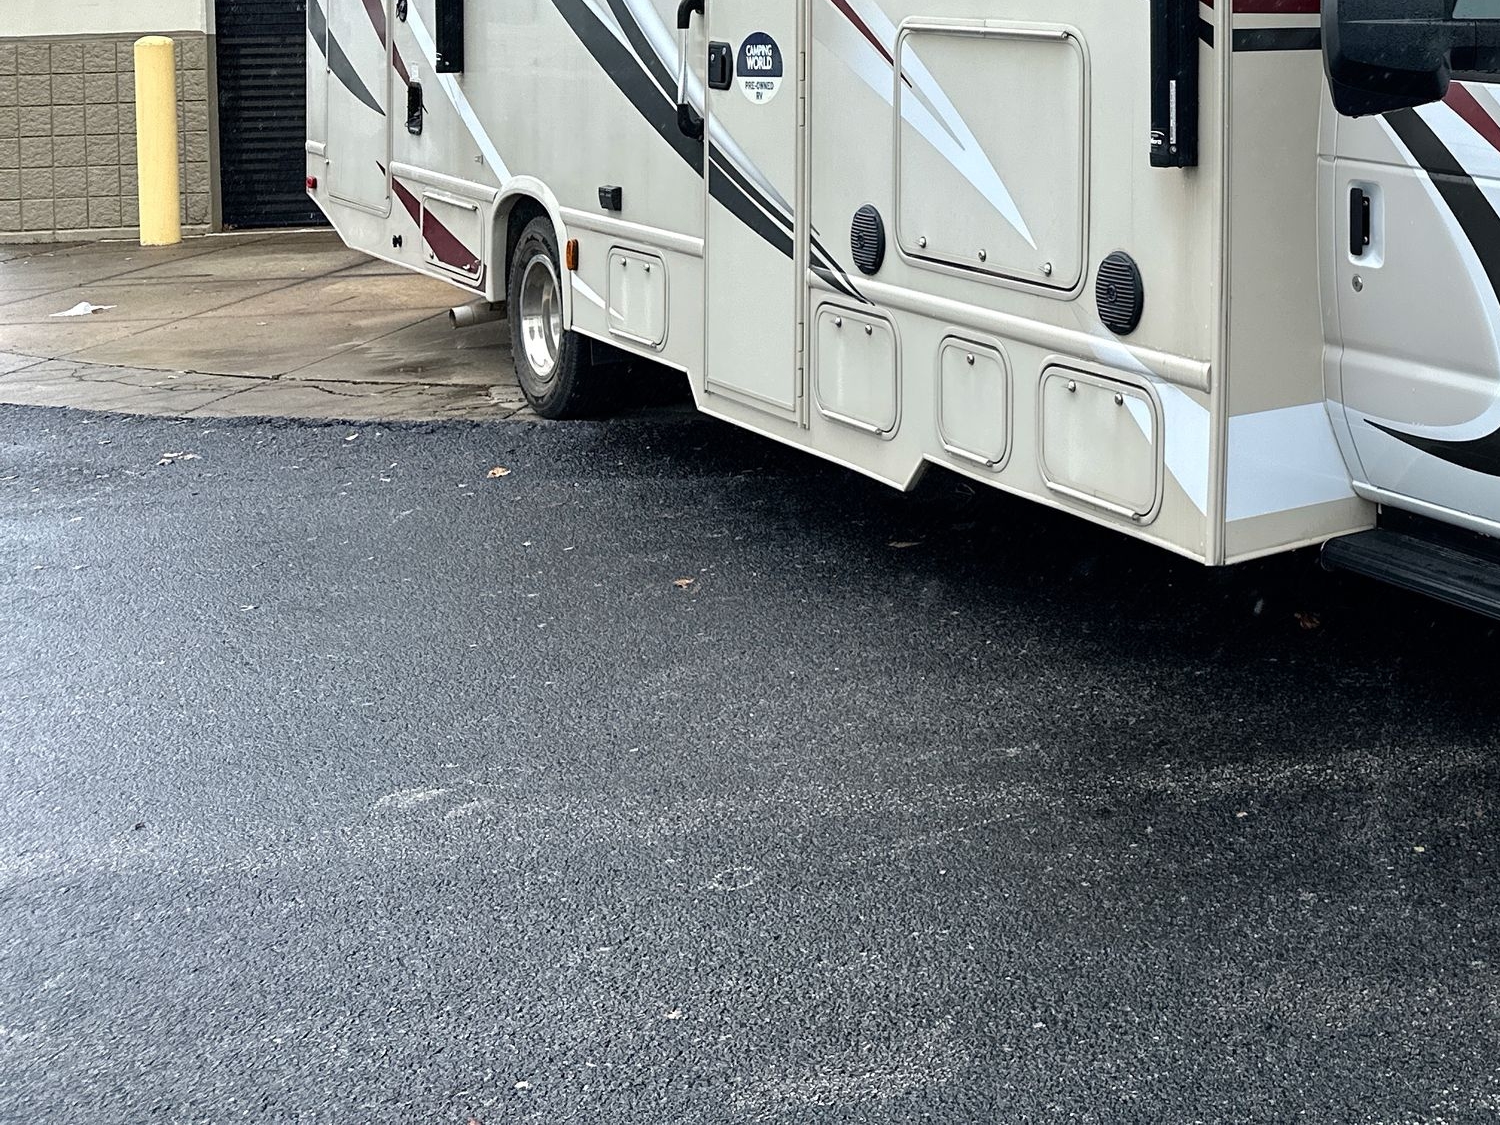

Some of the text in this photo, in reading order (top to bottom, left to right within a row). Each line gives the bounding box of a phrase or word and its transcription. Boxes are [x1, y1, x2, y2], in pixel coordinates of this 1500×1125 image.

[745, 44, 773, 56] CAMPING
[745, 55, 773, 70] WORLD
[744, 81, 775, 90] PRE-OWNED
